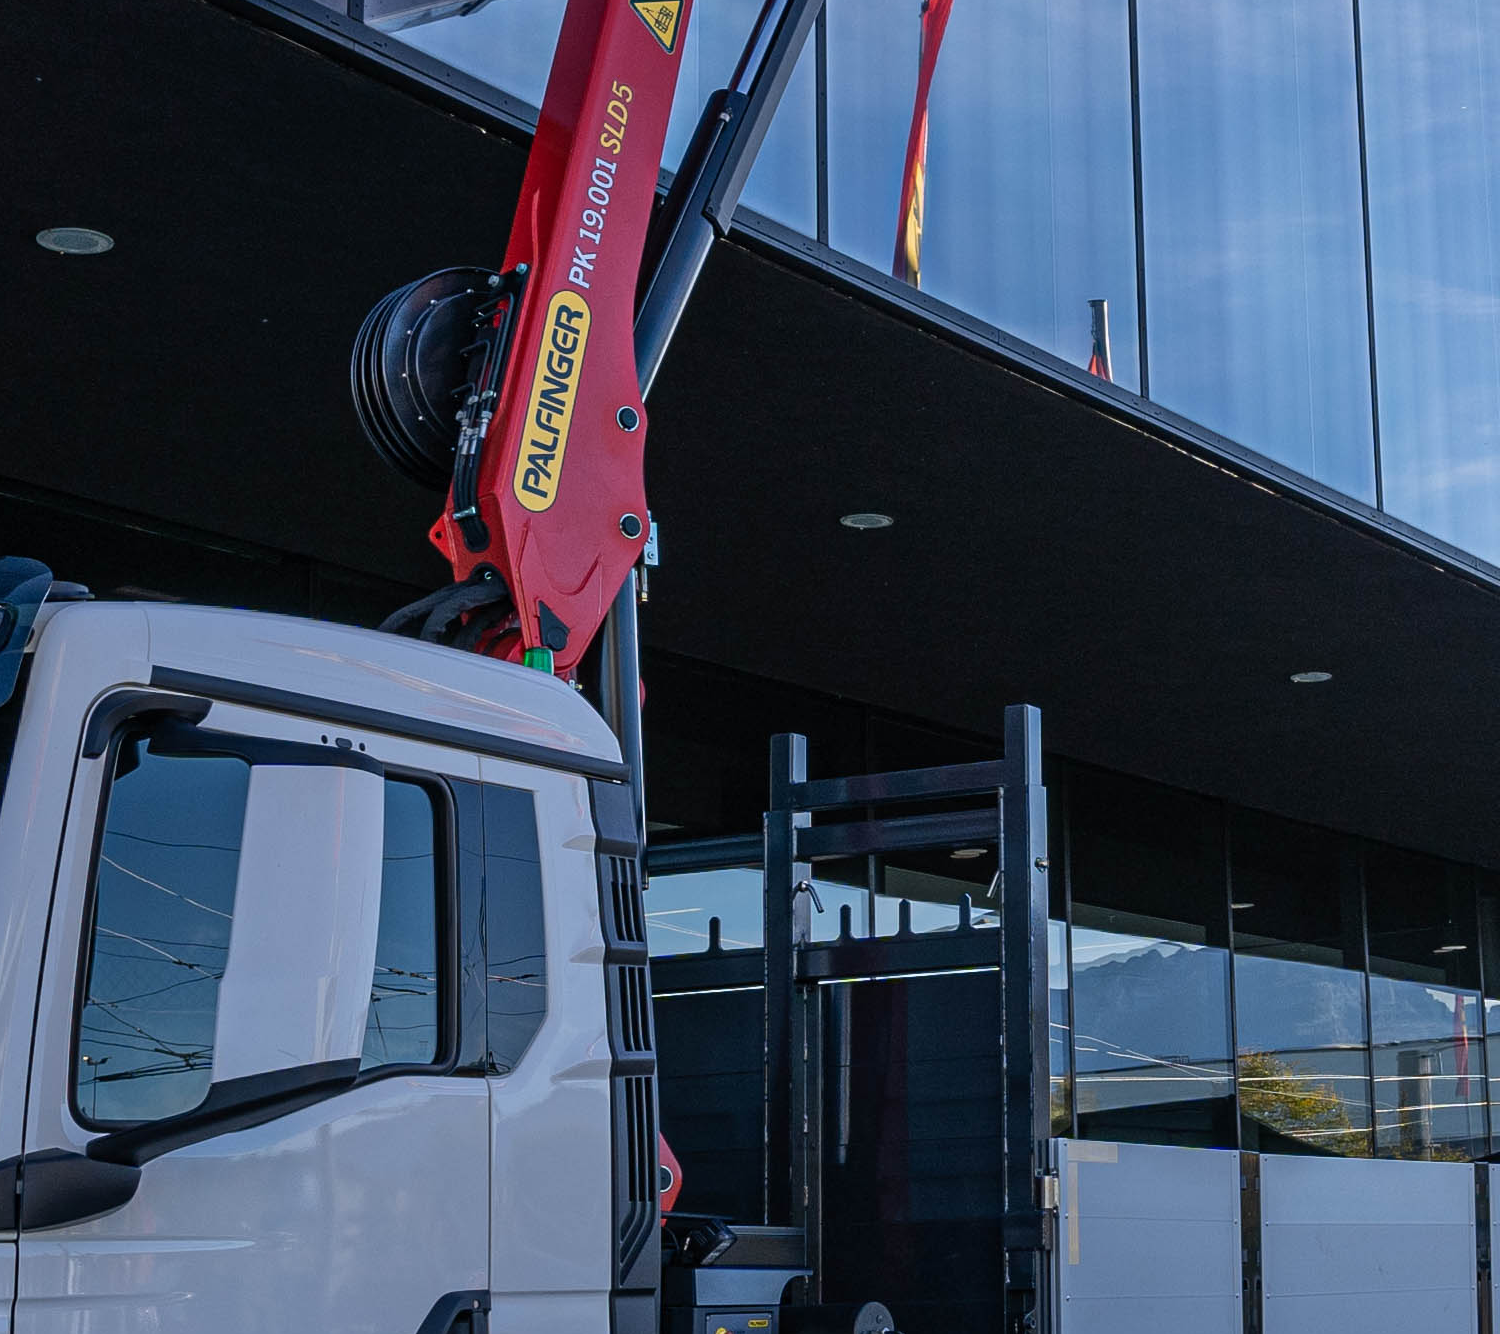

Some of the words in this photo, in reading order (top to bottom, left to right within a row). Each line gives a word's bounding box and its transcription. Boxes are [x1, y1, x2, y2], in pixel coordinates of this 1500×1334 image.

[579, 157, 618, 246] 19.001
[568, 245, 598, 289] PK
[521, 304, 585, 499] PALFINGER
